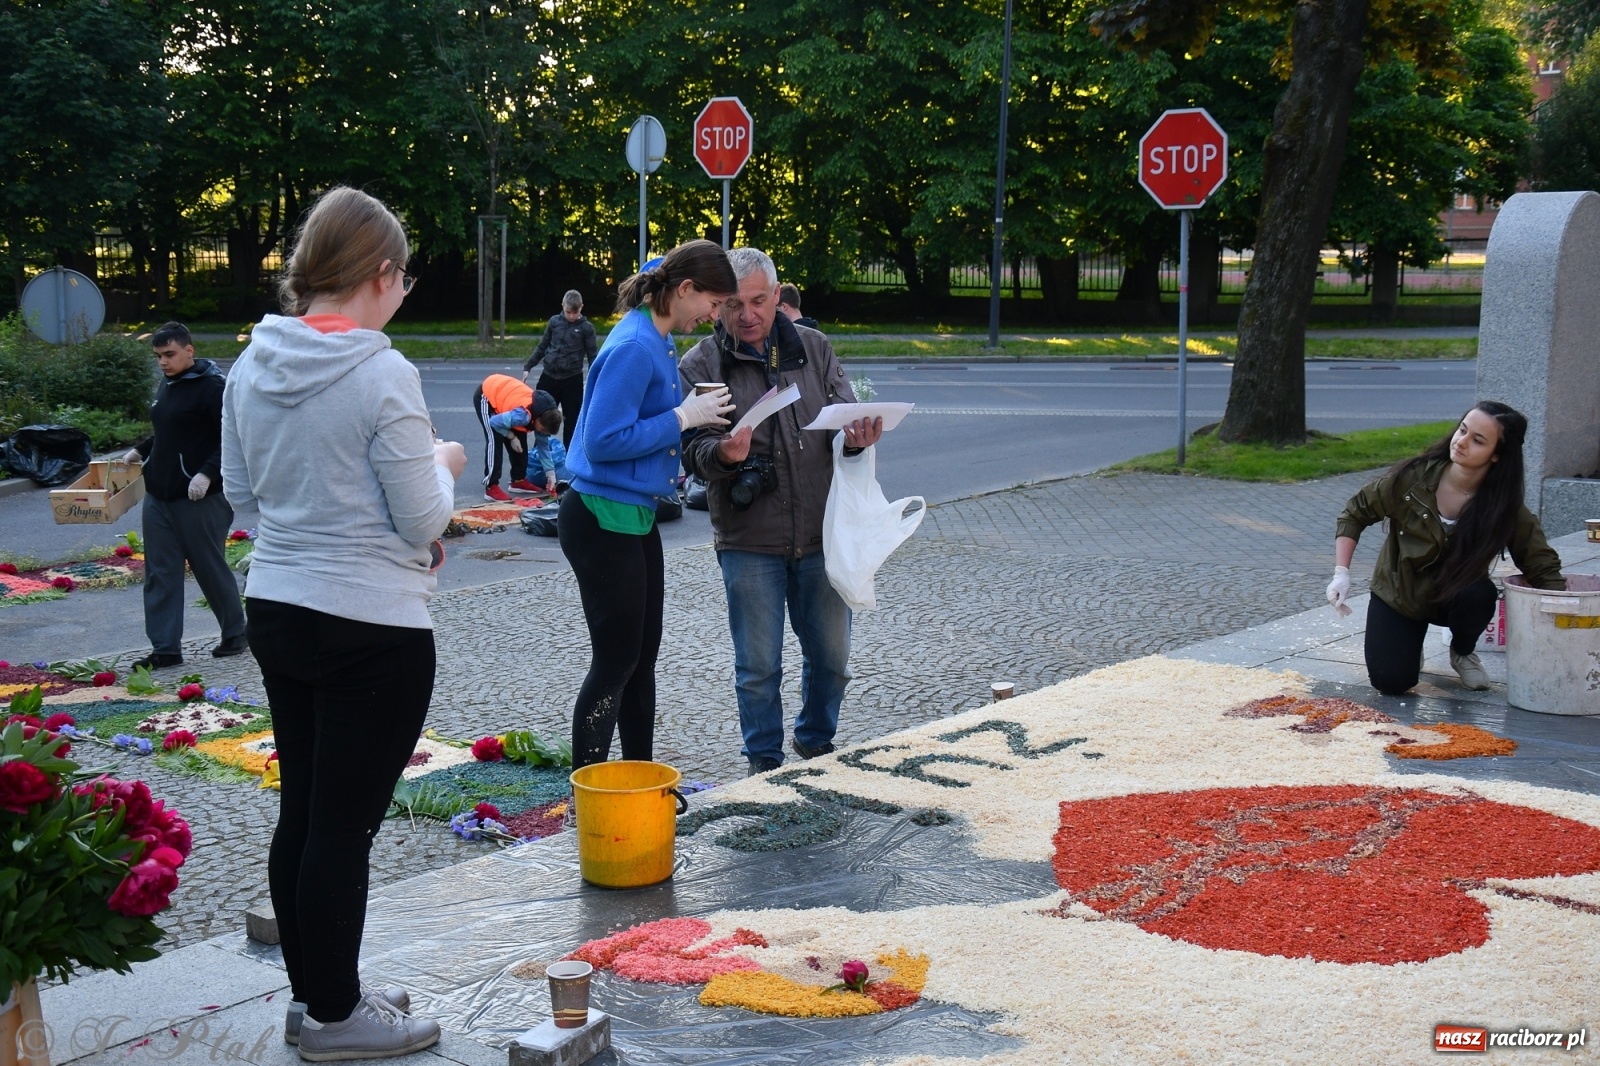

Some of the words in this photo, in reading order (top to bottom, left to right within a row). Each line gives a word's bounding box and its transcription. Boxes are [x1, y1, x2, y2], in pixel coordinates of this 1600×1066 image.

[701, 126, 746, 150] STOP
[1150, 143, 1217, 175] STOP
[55, 504, 102, 518] Rhyton
